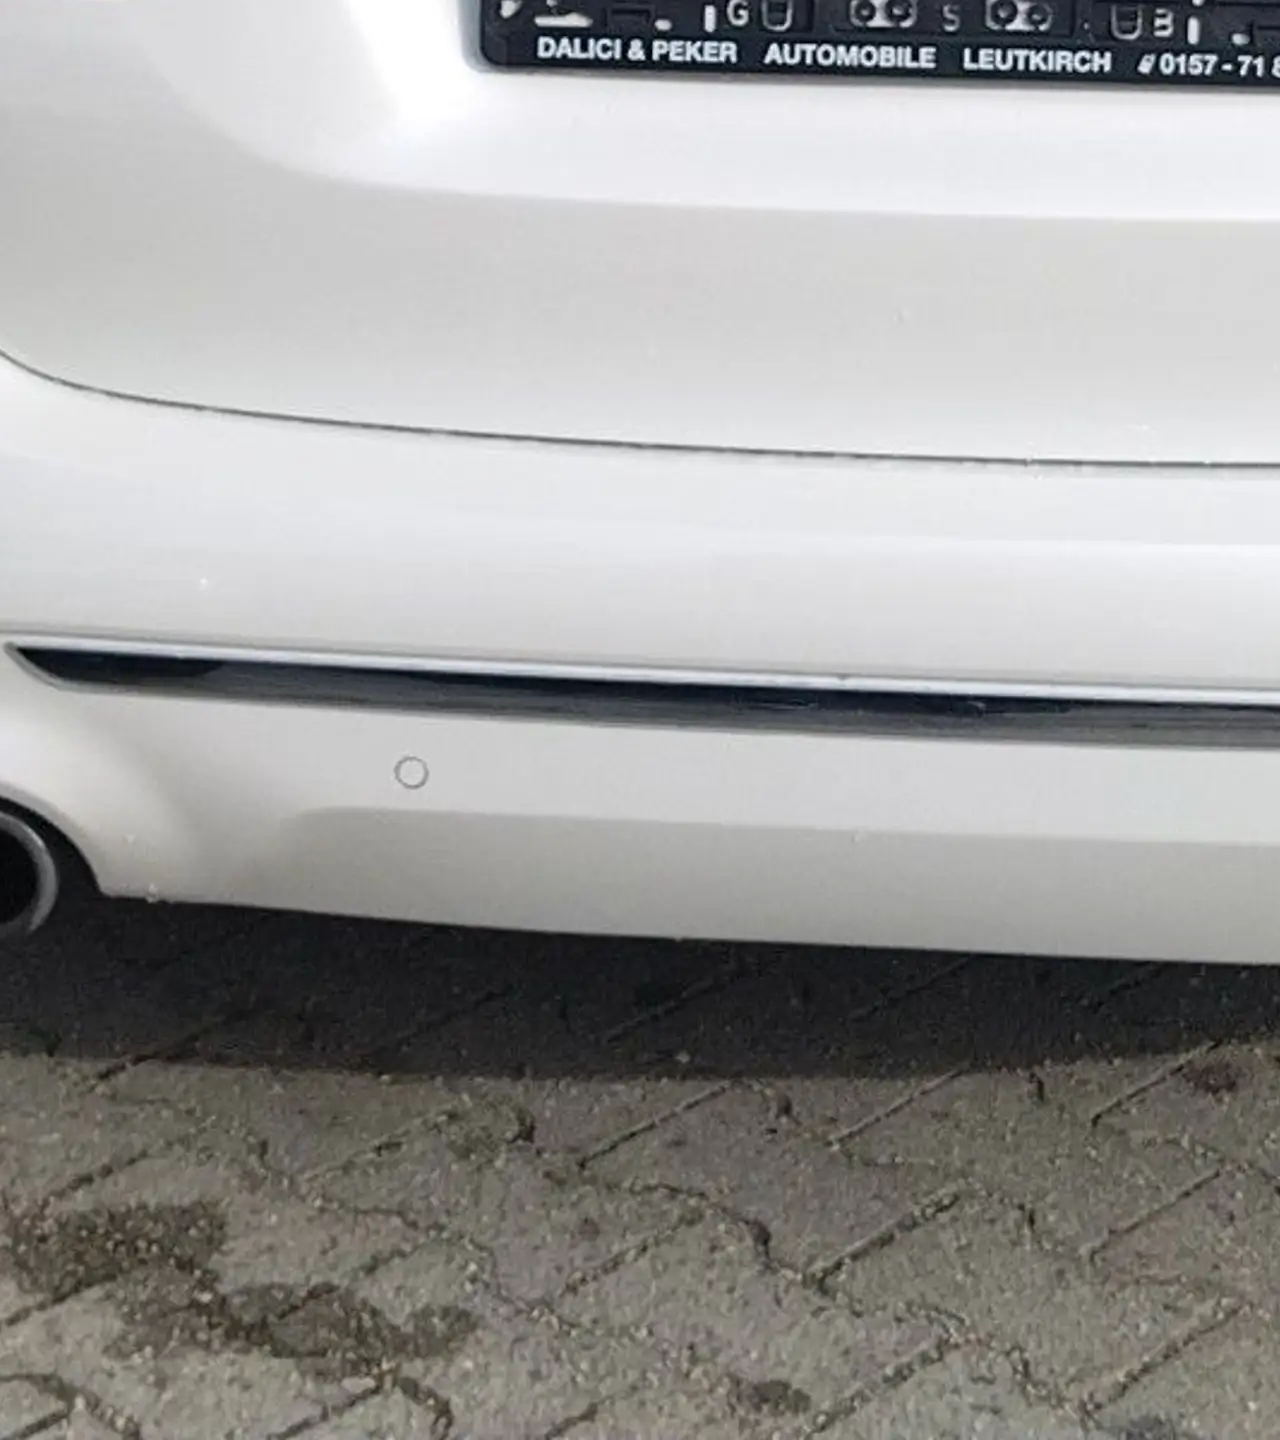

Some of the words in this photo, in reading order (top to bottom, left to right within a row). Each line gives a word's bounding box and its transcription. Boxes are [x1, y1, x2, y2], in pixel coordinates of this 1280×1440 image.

[537, 36, 621, 60] DALICI
[627, 39, 646, 61] &
[652, 39, 738, 63] PEKER
[764, 44, 936, 68] AUTOMOBILE
[962, 47, 1112, 73] LEUTKIRCH
[1159, 53, 1216, 76] 0157
[1238, 55, 1265, 77] 71
